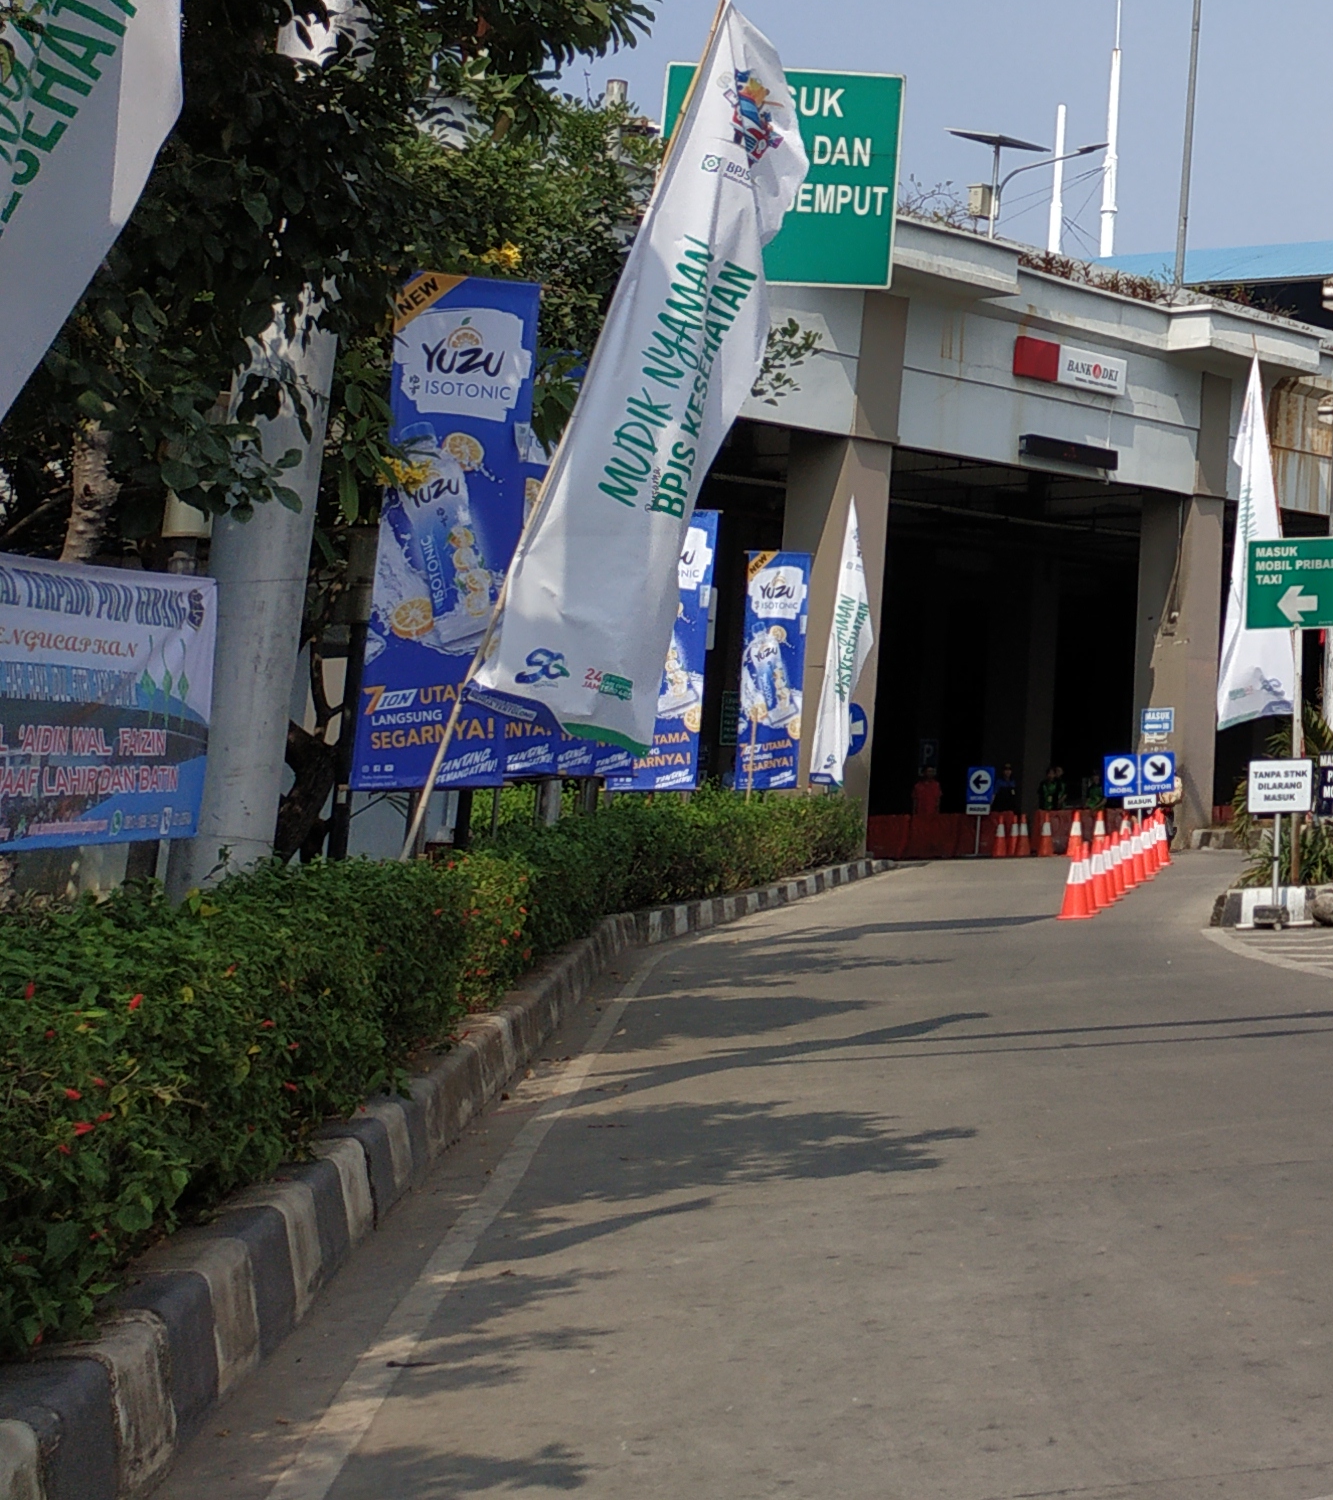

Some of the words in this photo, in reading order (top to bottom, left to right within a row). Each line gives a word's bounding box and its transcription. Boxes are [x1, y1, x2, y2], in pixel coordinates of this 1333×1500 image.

[813, 135, 872, 167] DAN
[725, 161, 751, 182] BPJS
[397, 277, 440, 317] NEW
[422, 337, 505, 378] YUZU
[598, 387, 674, 508] MUDIK
[641, 233, 714, 390] NYAMAN
[1066, 360, 1093, 376] BANK
[1101, 368, 1120, 382] DKI
[425, 380, 512, 401] ISOTONIC
[653, 441, 696, 520] BPJS
[680, 260, 758, 440] KESEHATAN
[410, 477, 460, 509] YUZU
[1255, 546, 1298, 558] MASUK
[421, 534, 445, 610] ISOTONIC
[749, 554, 767, 575] NEW
[1255, 560, 1293, 571] MOBIL
[1255, 574, 1282, 585] TAXI
[12, 567, 95, 617] TERPADU
[135, 585, 188, 630] GEBANG
[759, 582, 795, 599] YUZU
[761, 601, 798, 610] ISOTONIC
[753, 646, 778, 662] YUZU
[363, 685, 387, 716] 7
[379, 691, 413, 709] ION
[420, 681, 464, 705] UTA
[371, 709, 443, 727] LANGSUNG
[1144, 711, 1171, 720] MASUK
[72, 726, 114, 756] WAL
[371, 717, 495, 750] SEGARNYA!
[654, 731, 690, 745] TAMA
[762, 739, 793, 751] UTAMA
[742, 756, 794, 773] SGARNYA!
[0, 765, 41, 798] AAF
[43, 765, 99, 797] LAHIR
[98, 764, 137, 795] DAN
[138, 764, 180, 794] BATIN
[1253, 771, 1282, 779] TANPA
[1283, 769, 1308, 778] STNK
[1109, 786, 1134, 795] MOBIL
[1143, 783, 1172, 792] MOTOR
[1257, 781, 1303, 791] DILARANG
[1127, 798, 1153, 806] MASUK
[1263, 793, 1296, 802] MASUK
